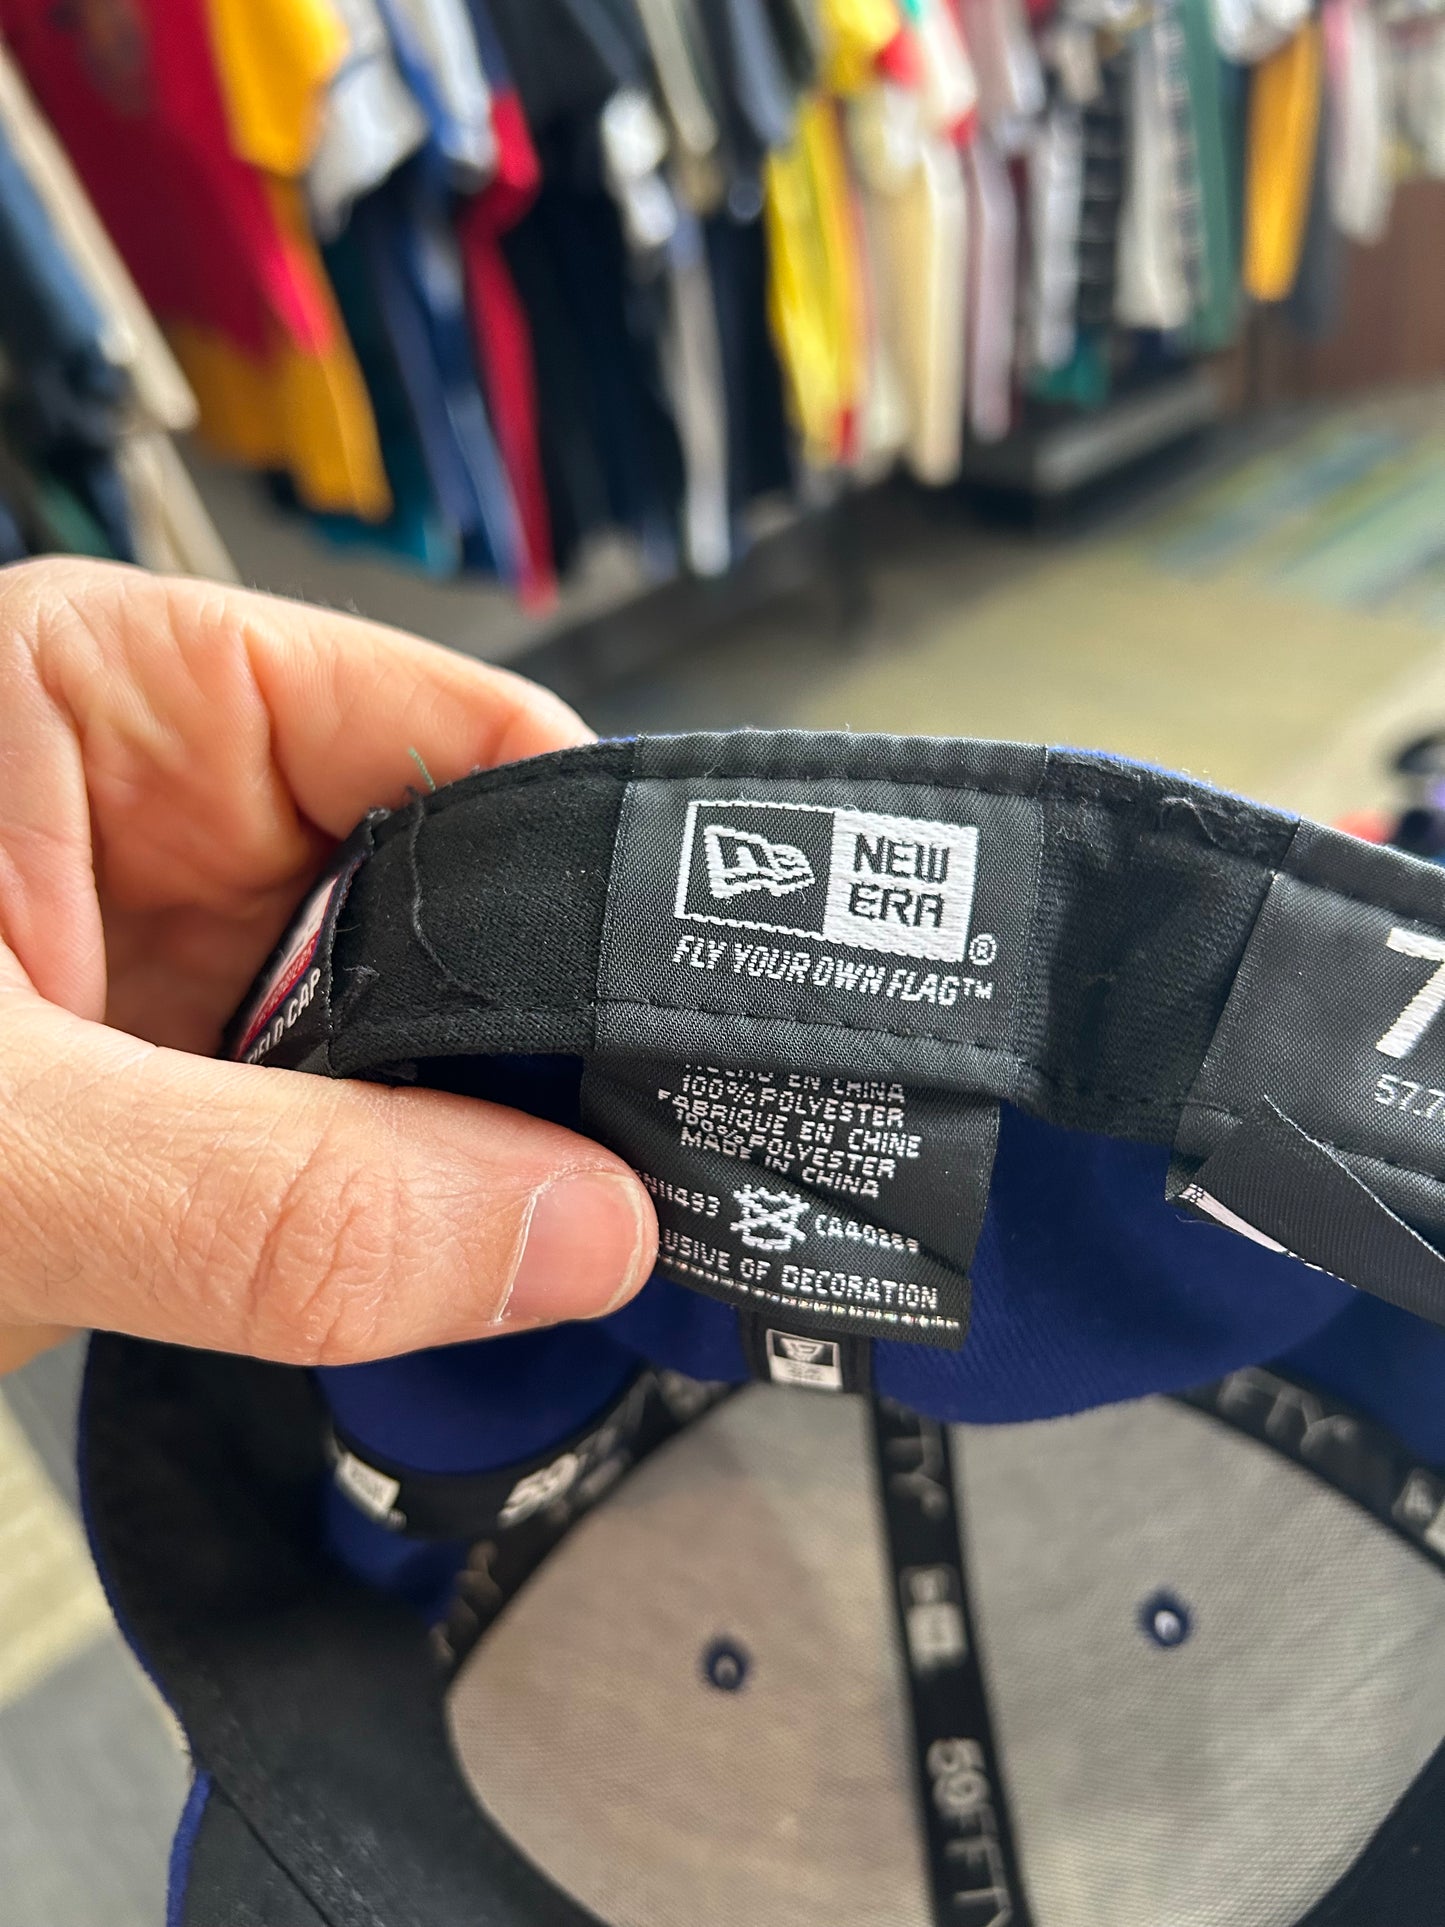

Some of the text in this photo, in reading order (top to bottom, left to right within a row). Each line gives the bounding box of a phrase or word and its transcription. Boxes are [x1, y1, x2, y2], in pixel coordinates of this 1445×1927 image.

[853, 833, 950, 884] NEW
[849, 881, 944, 928] ERA
[673, 935, 728, 970] FLY
[733, 942, 811, 983] YOUR
[812, 956, 887, 996] OWN
[287, 967, 321, 1029] CAP
[658, 1088, 922, 1158] FABRIQUE EN CHINE
[680, 1126, 879, 1198] MADE IN CHINA
[659, 1228, 938, 1310] USIVE OF DECORATION
